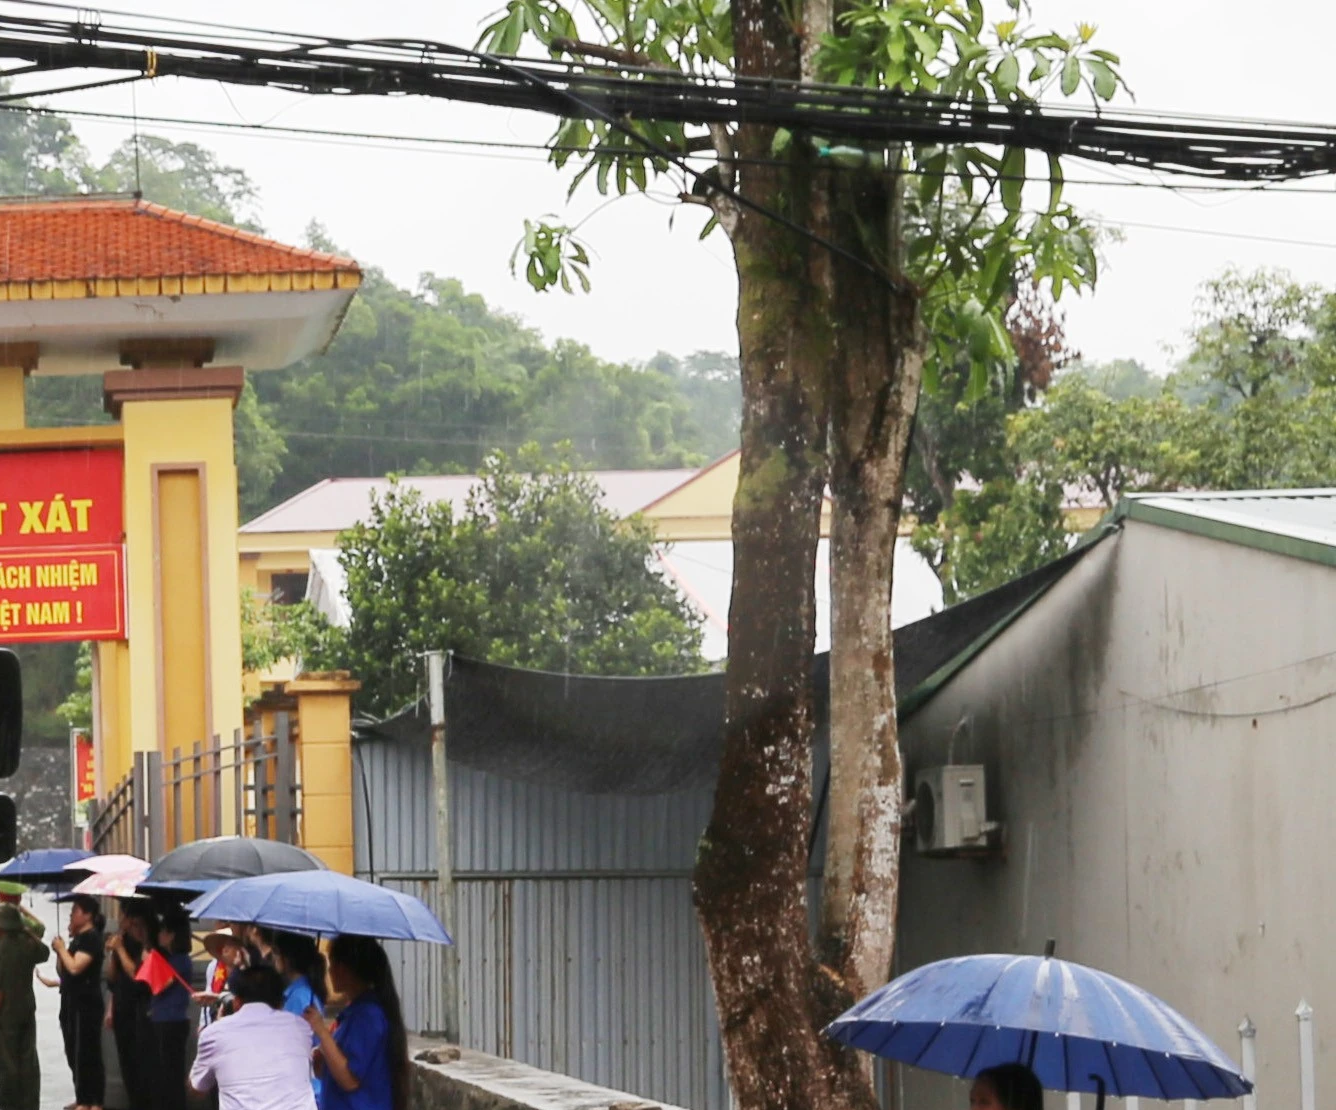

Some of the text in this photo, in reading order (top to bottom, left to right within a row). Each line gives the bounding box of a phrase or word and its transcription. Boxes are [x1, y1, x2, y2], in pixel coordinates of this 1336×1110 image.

[19, 493, 93, 535] XÁT
[35, 559, 98, 592] NHIỆM
[26, 602, 70, 625] NAM
